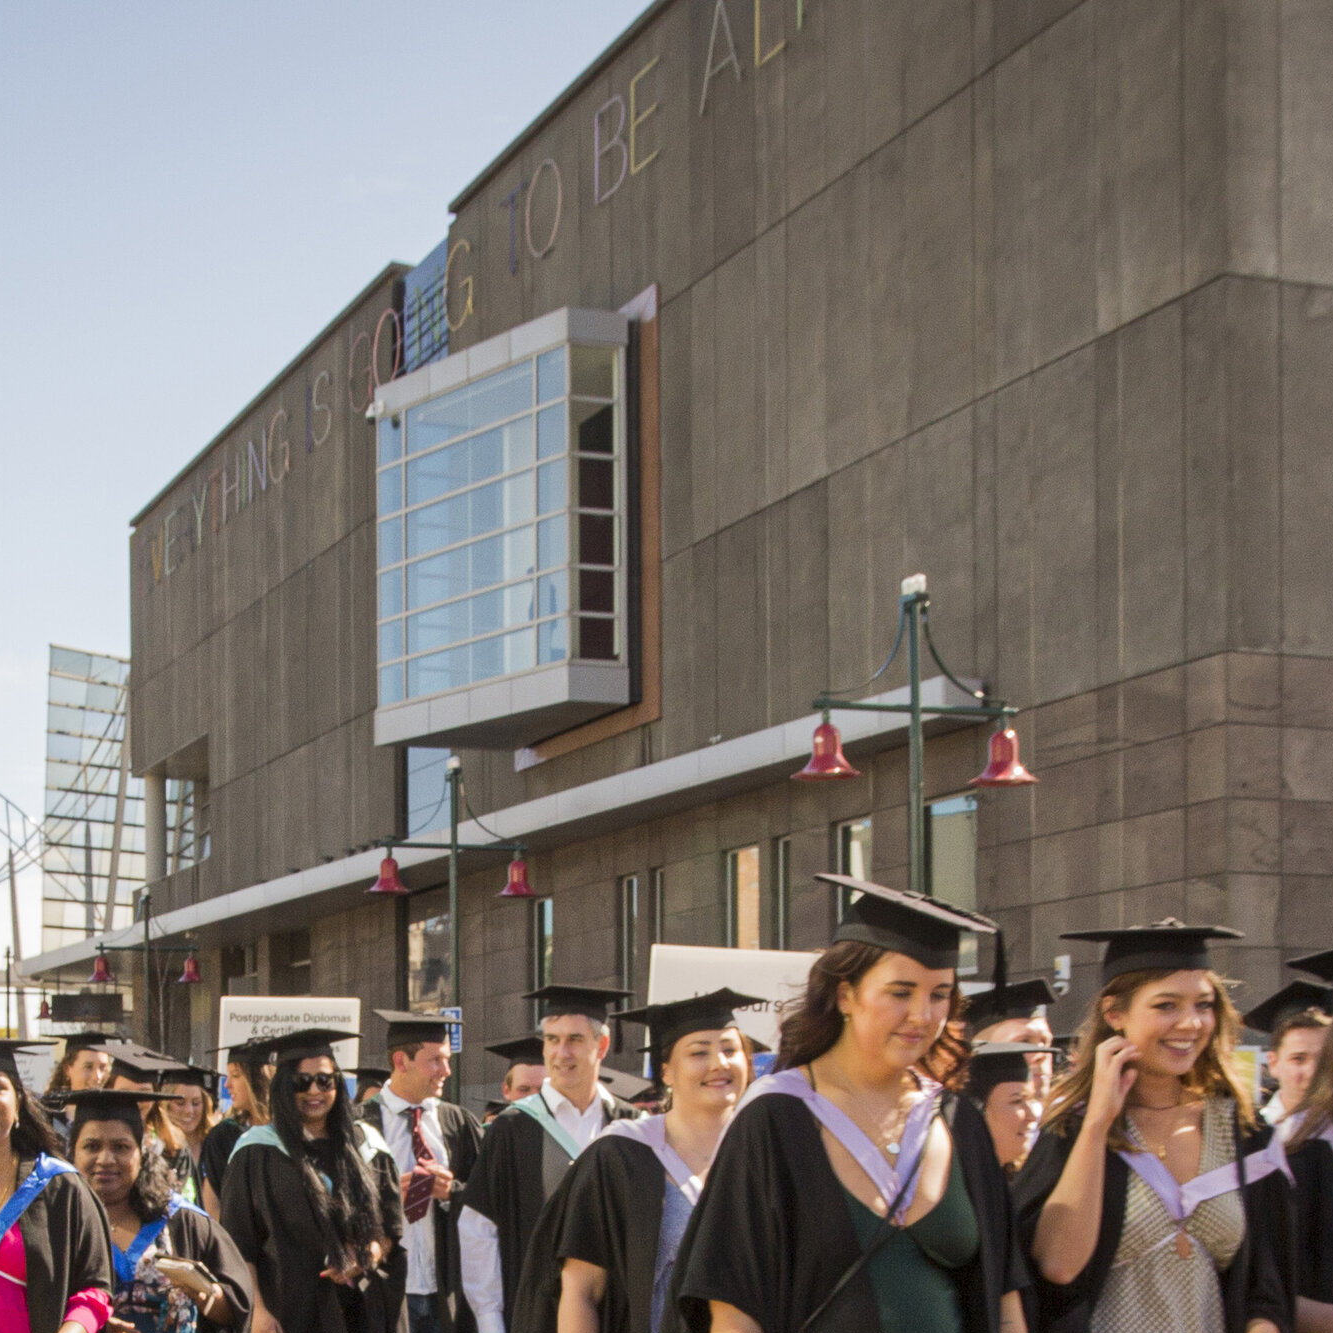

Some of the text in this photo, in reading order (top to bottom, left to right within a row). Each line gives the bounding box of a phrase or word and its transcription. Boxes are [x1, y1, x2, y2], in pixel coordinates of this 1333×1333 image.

[499, 157, 563, 276] TO
[593, 55, 661, 206] BE
[229, 1012, 353, 1026] Postgraduate Diplomas
[250, 1026, 259, 1037] &
